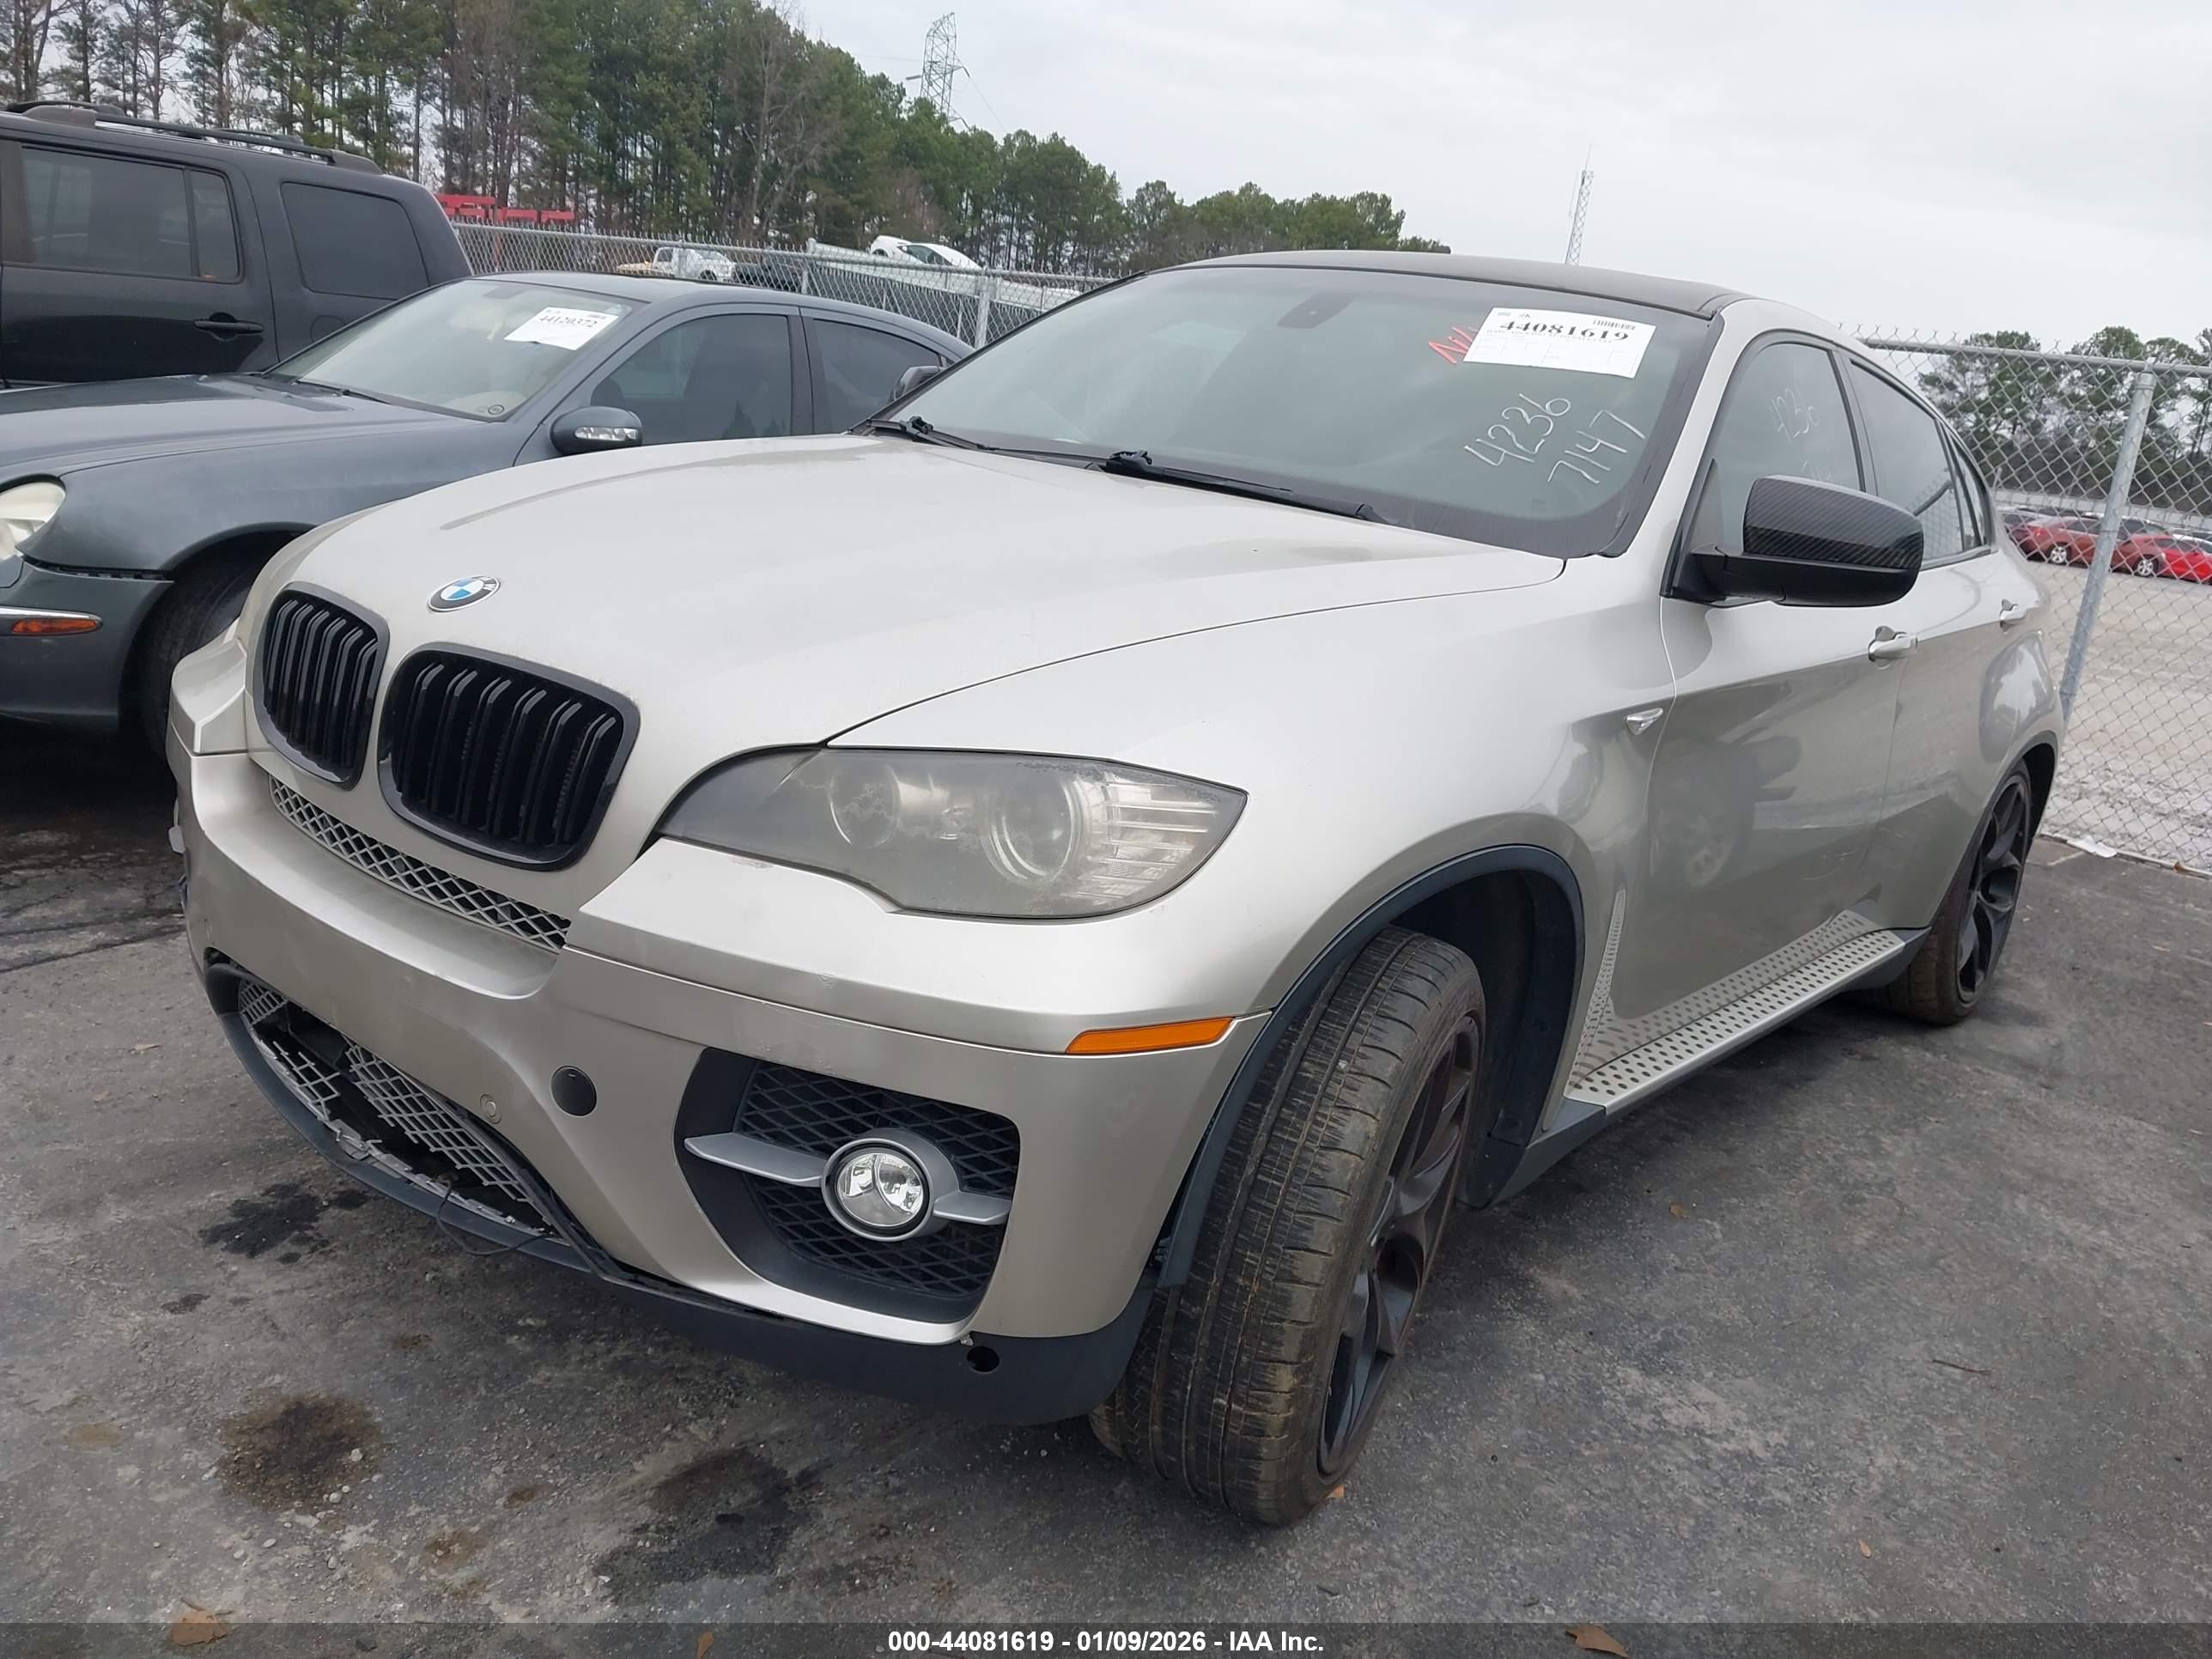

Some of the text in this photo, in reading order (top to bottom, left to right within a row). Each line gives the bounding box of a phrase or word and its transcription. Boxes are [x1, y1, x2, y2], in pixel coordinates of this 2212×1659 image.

[1500, 320, 1630, 342] 44081619
[1463, 392, 1571, 467] 4236
[1547, 409, 1646, 483] 7147
